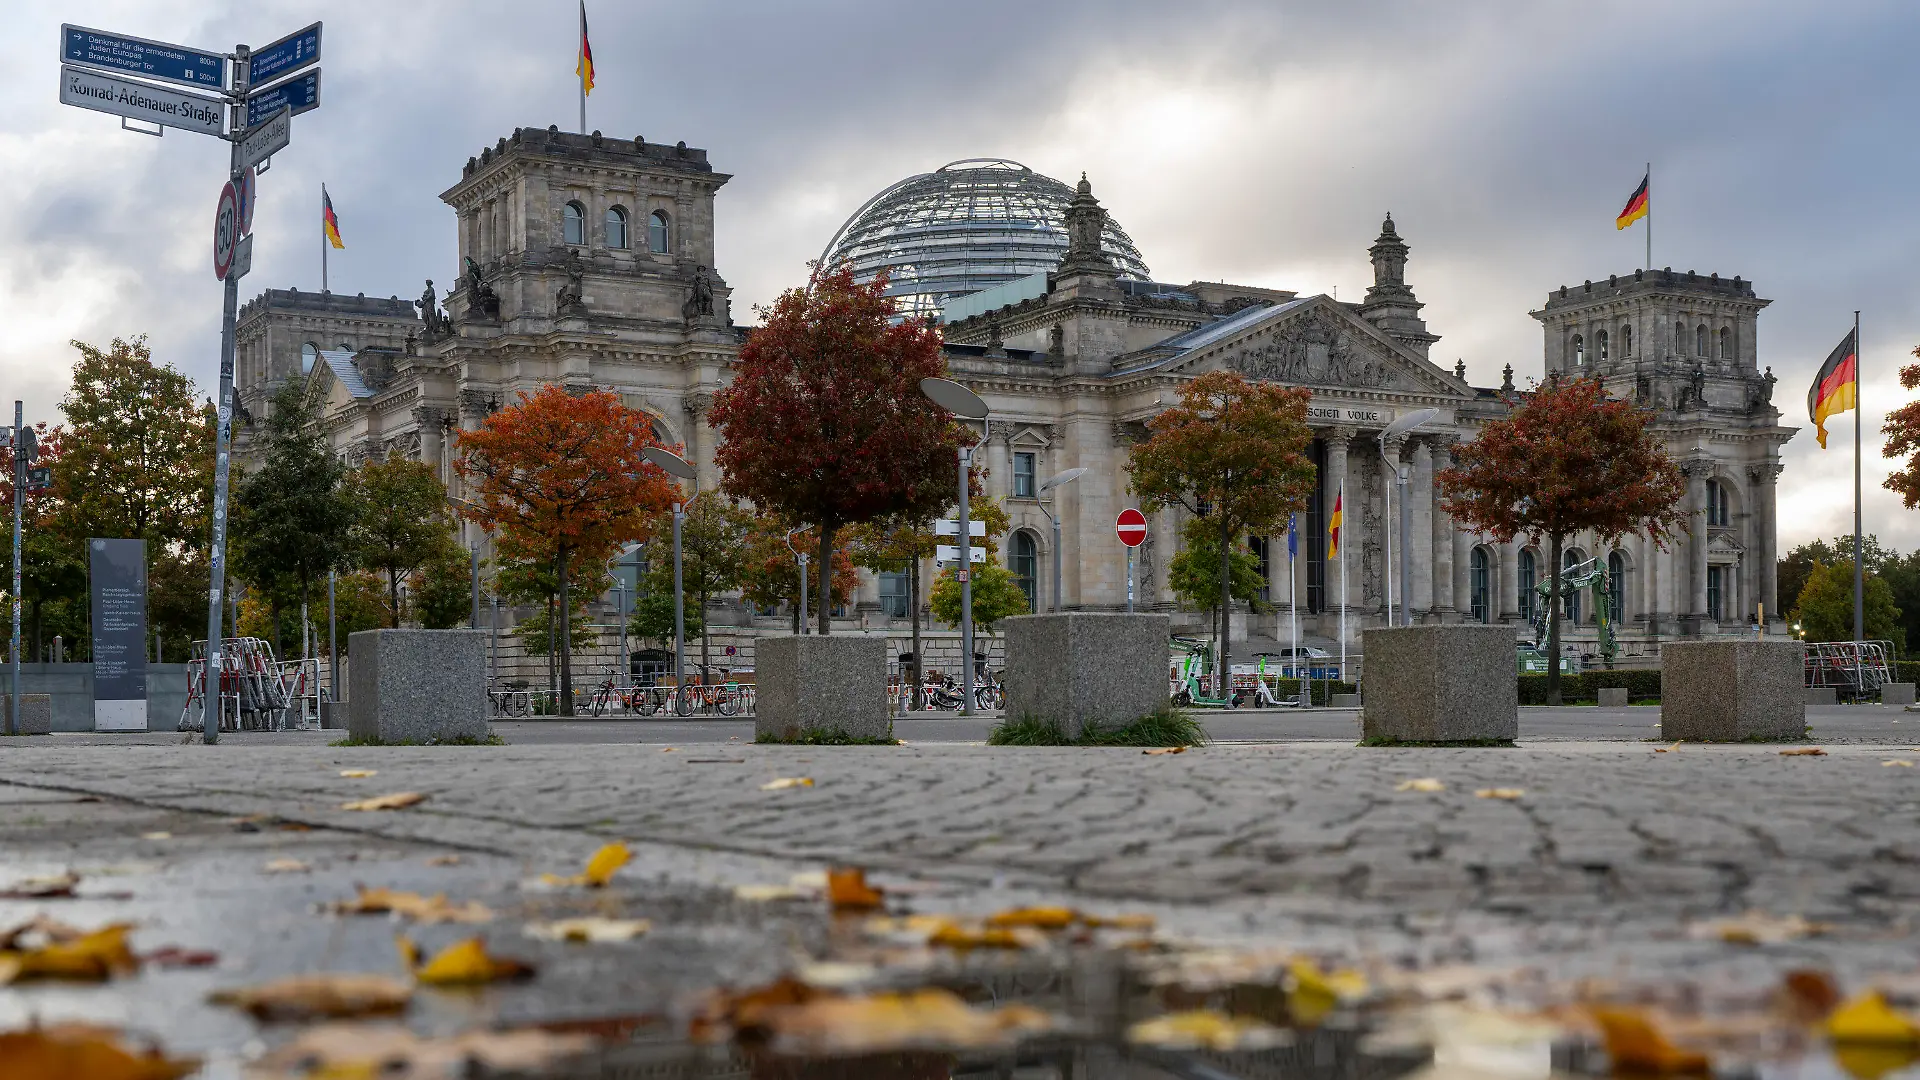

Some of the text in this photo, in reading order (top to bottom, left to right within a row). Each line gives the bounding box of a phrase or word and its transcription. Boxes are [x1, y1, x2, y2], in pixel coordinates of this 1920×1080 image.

[88, 35, 186, 61] Denkmal für die ermordeten
[88, 44, 142, 60] Juden Europas
[88, 52, 155, 70] Brandenburger Tor
[199, 57, 216, 67] 800m
[199, 72, 216, 82] 500m
[69, 76, 219, 126] Konrad-Adenauer-Straße
[218, 207, 233, 255] 50
[1307, 407, 1378, 421] SCHEN VOLKE
